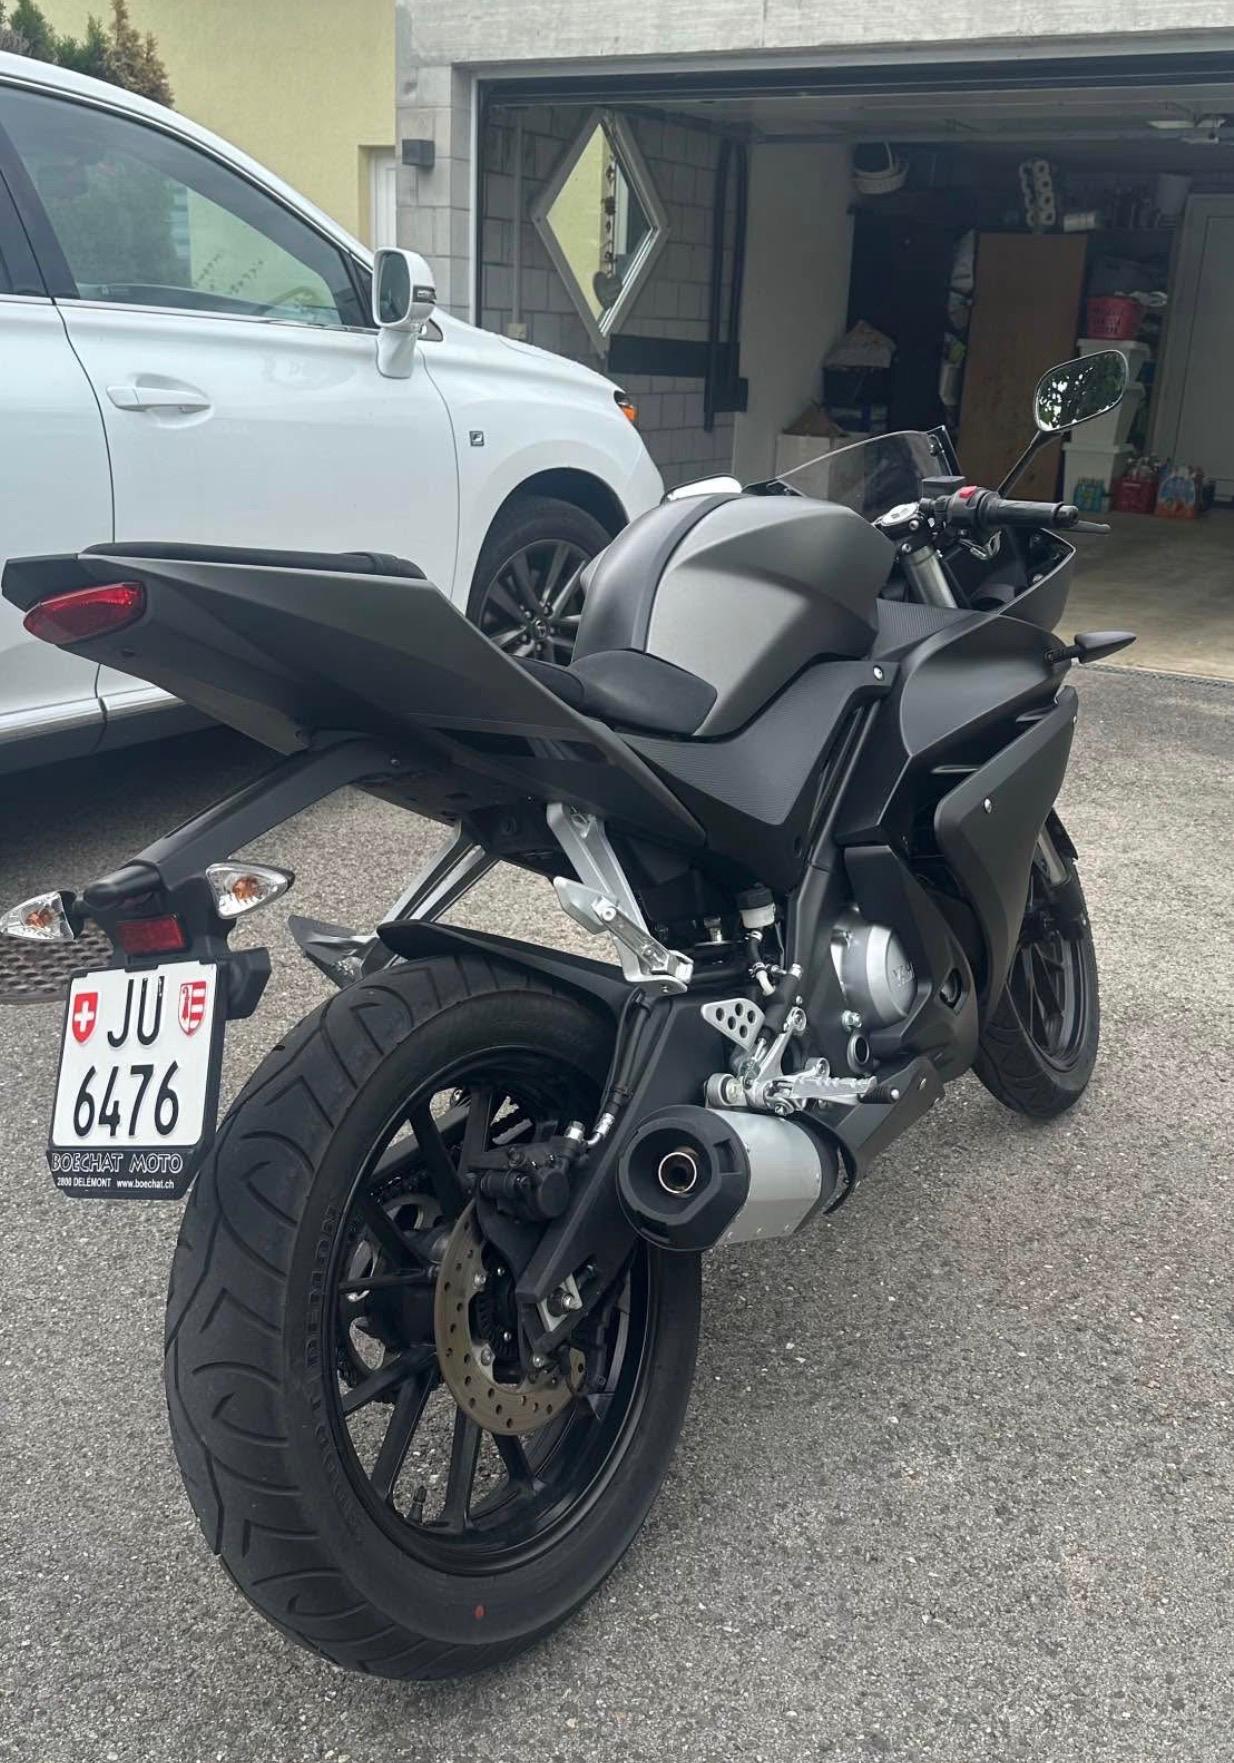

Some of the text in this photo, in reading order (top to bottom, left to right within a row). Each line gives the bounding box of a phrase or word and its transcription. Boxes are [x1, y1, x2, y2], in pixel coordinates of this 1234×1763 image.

[107, 976, 165, 1047] JU
[73, 1061, 179, 1137] 6476
[51, 1152, 183, 1173] BOECHAT MOTO
[116, 1178, 175, 1189] www.boechat.ch
